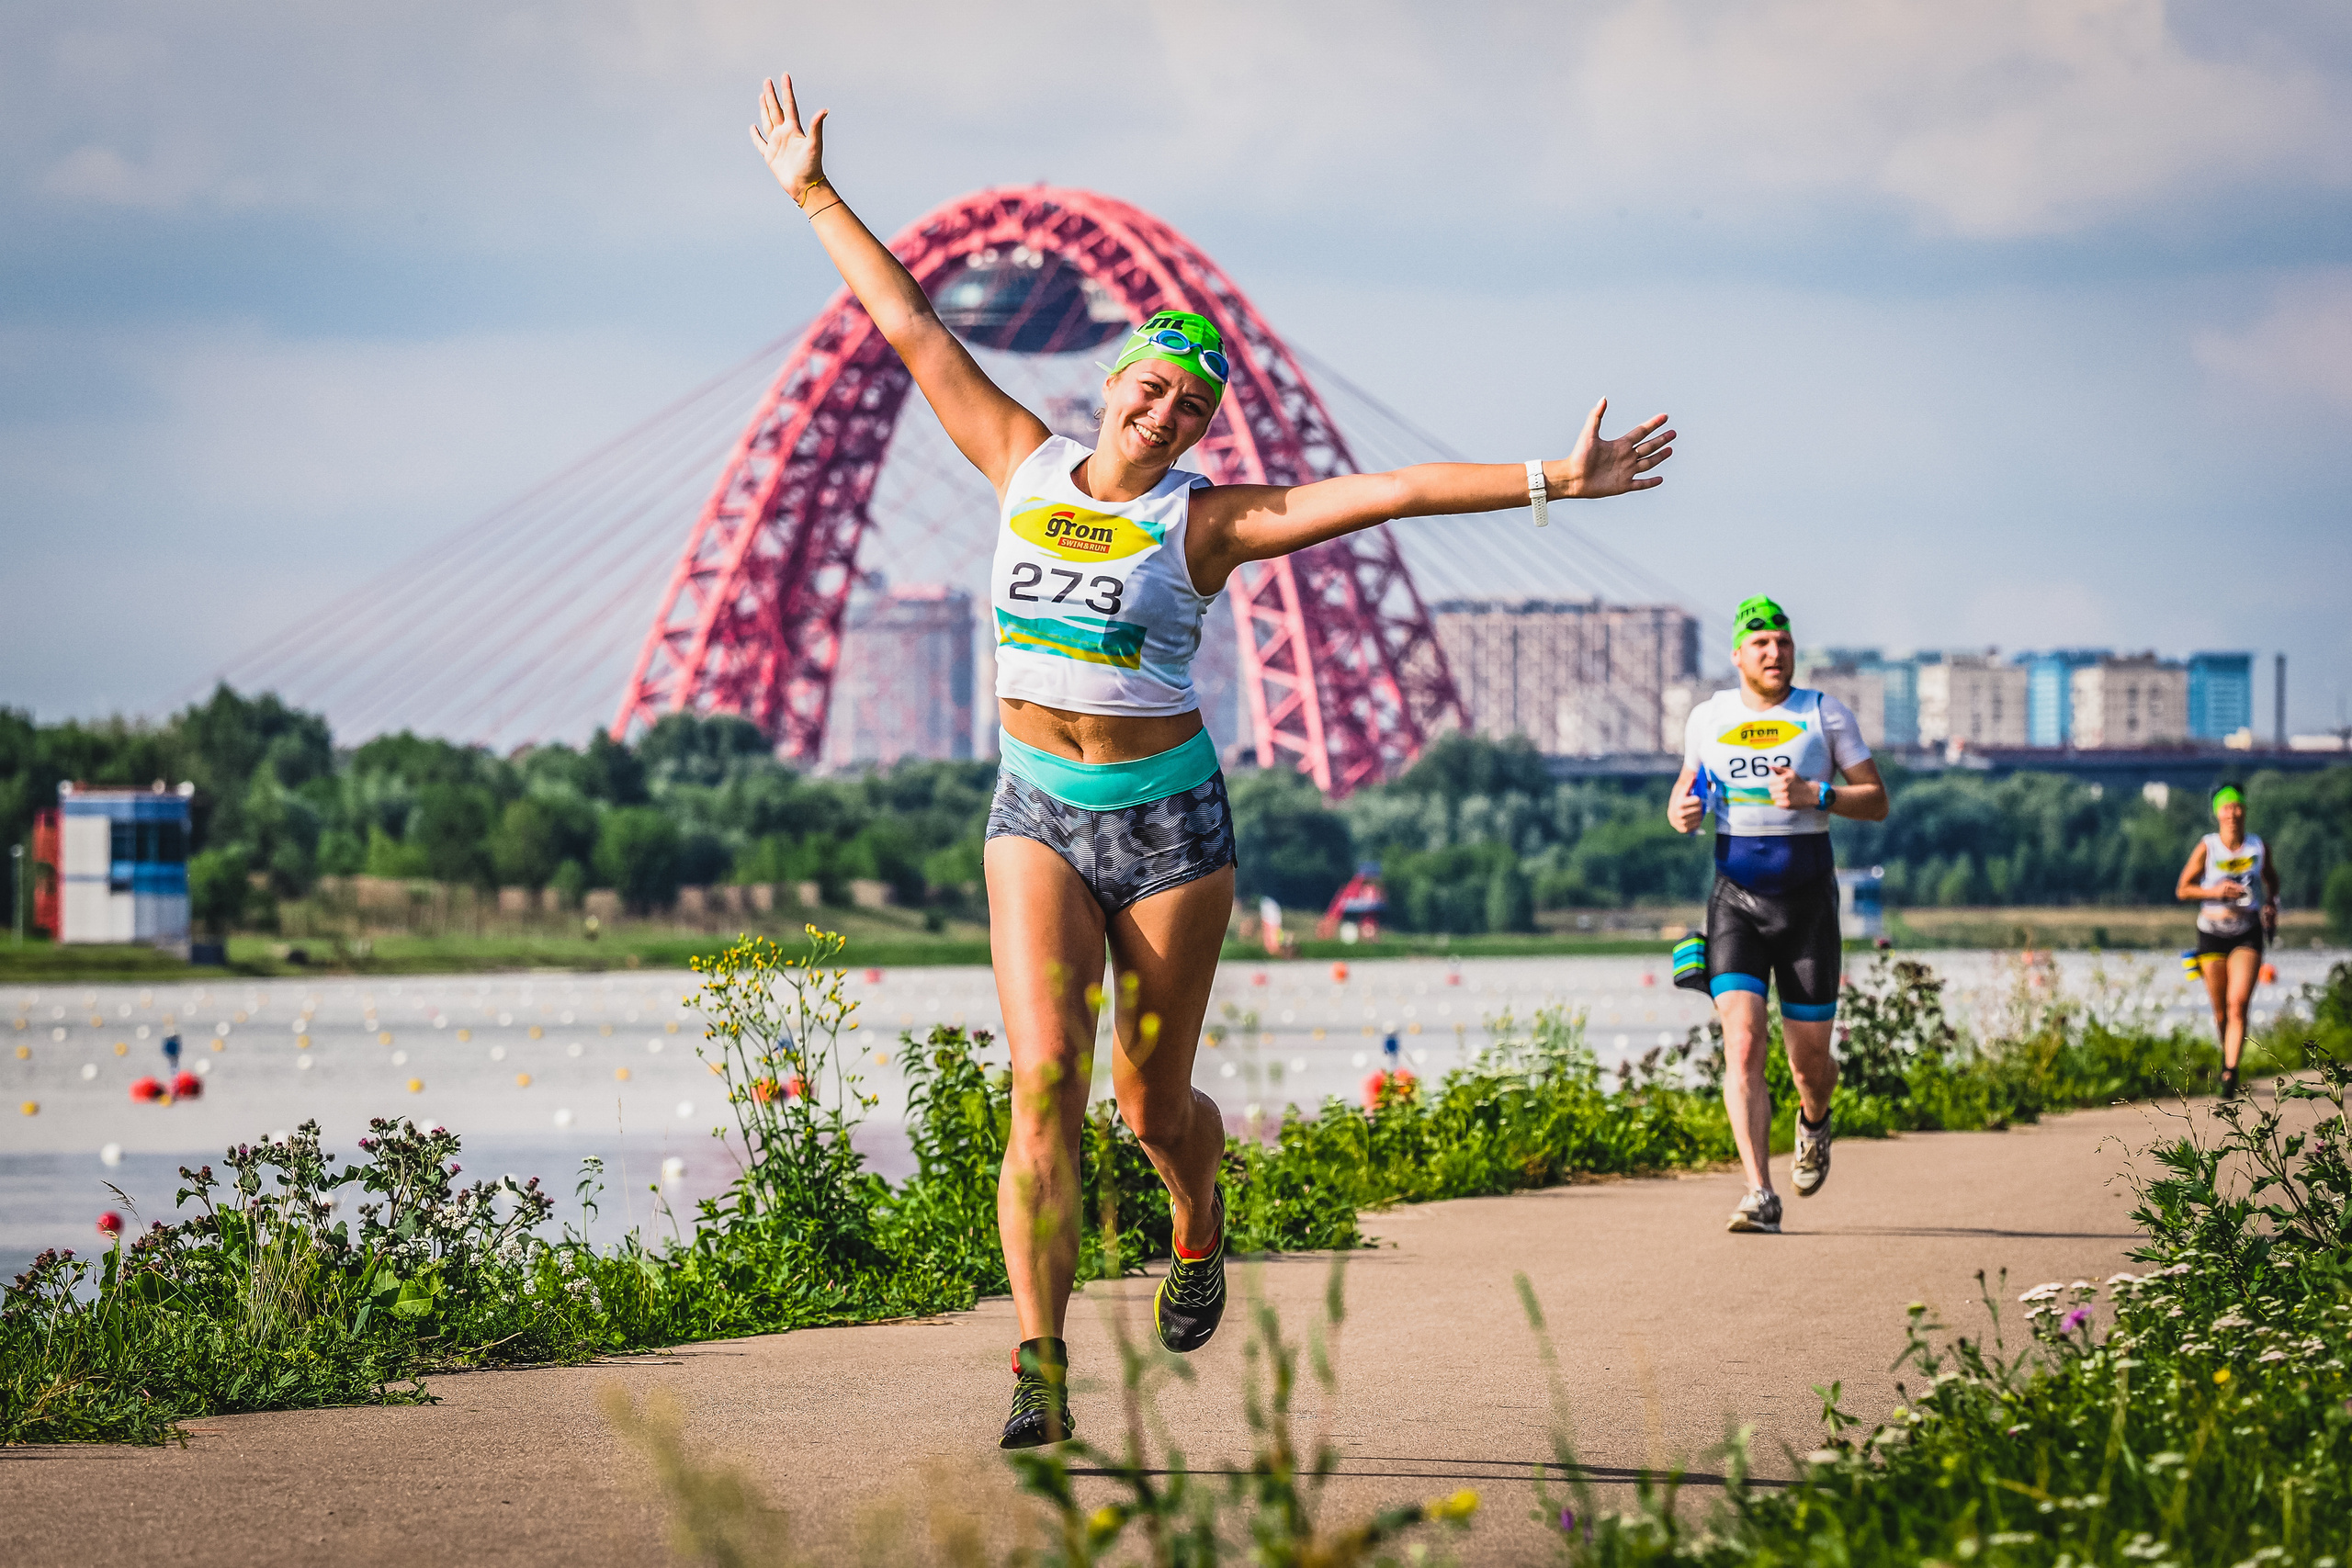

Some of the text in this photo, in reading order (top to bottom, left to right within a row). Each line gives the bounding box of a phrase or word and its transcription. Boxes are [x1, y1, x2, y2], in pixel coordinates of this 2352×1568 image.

[1045, 517, 1114, 543] grom
[1060, 538, 1107, 552] SWIM&RUN
[1009, 562, 1125, 615] 273
[1740, 728, 1779, 740] grom
